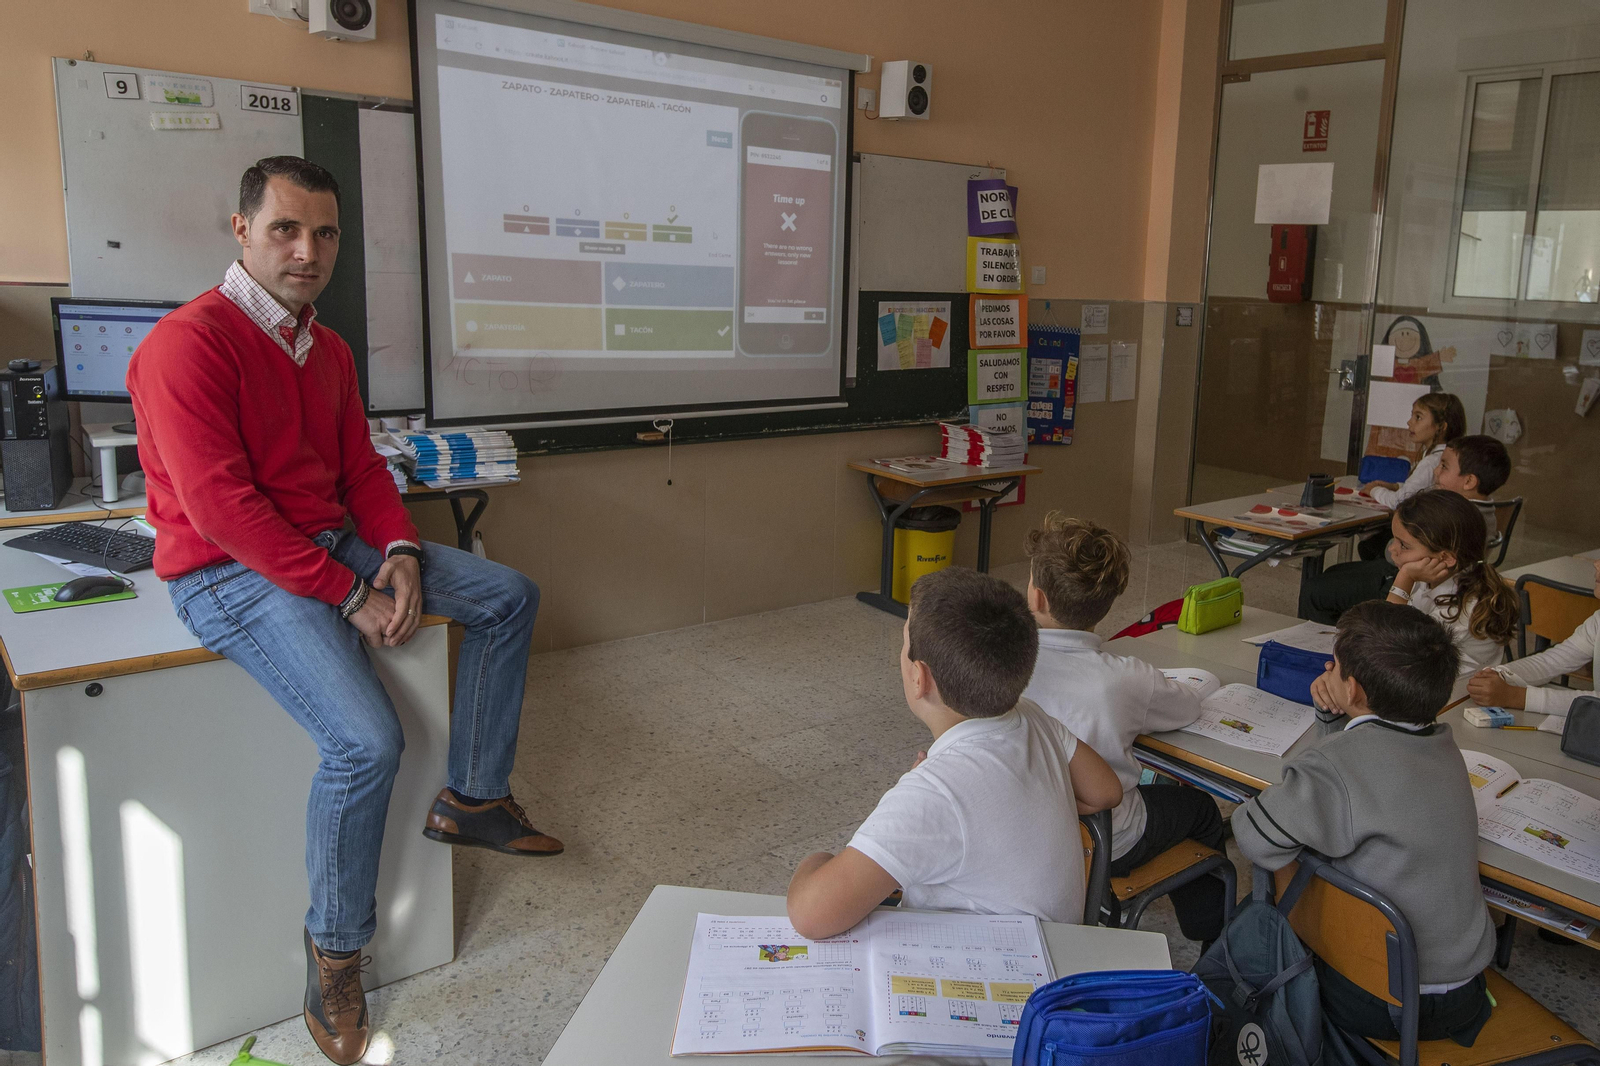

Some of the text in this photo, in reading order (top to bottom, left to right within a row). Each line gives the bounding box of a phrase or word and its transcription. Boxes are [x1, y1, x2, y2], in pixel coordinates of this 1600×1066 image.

[116, 80, 128, 94] 9
[149, 80, 207, 92] NOVEMBER
[248, 93, 292, 112] 2018
[501, 81, 692, 114] ZAPATO ZAPATERO ZAPATERÍA TACÓN
[159, 117, 211, 125] FRIDAY
[711, 135, 729, 145] Next
[1303, 142, 1327, 150] EXTINTOR
[773, 194, 806, 207] Time up
[981, 209, 997, 220] DE
[980, 247, 1014, 258] TRABAJO
[982, 261, 1015, 270] SILENCIO
[481, 273, 512, 283] ZAPATO
[983, 274, 1018, 283] EN ORDEN
[629, 280, 665, 289] ZAPATERO
[981, 304, 1010, 313] PEDIMOS
[979, 317, 1014, 326] LAS COSAS
[483, 322, 526, 332] ZAPATERÍA
[630, 325, 653, 335] TACÓN
[979, 330, 1016, 339] POR FAVOR
[979, 357, 1020, 367] SALUDAMOS
[994, 371, 1008, 379] CON
[986, 383, 1014, 393] RESPETO
[996, 413, 1007, 421] NO
